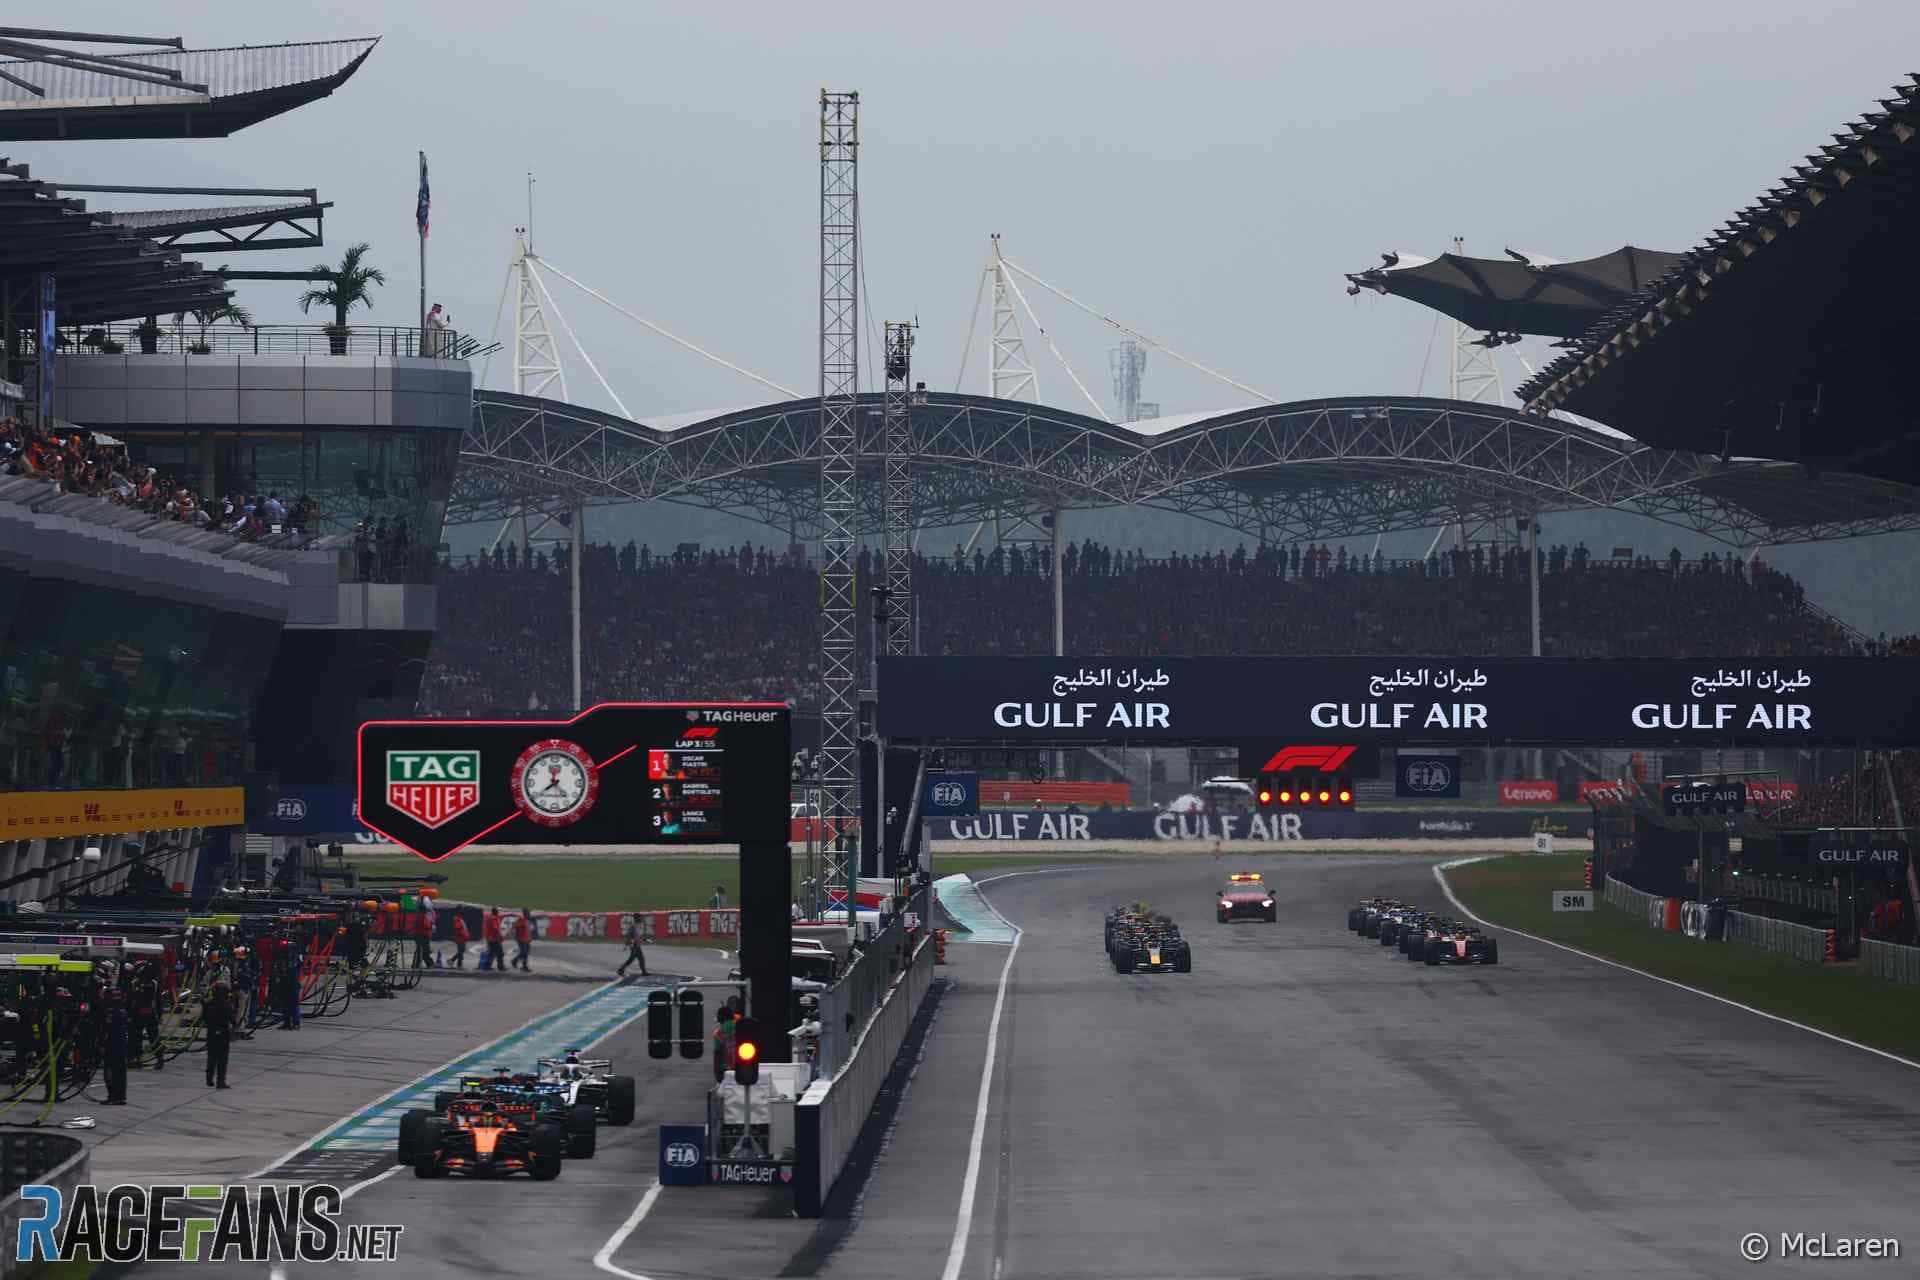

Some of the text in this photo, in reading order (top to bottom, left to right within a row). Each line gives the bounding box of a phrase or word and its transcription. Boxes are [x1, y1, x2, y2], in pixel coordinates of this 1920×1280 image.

[1052, 668, 1170, 697] طيران الخليج
[1369, 668, 1488, 697] طيران الخليج
[1691, 669, 1811, 698] طيران الخليج
[993, 702, 1171, 728] GULF AIR
[1310, 702, 1488, 729] GULF AIR
[1631, 703, 1812, 730] GULF AIR
[675, 740, 694, 748] LAP
[394, 756, 471, 779] TAG
[652, 760, 661, 771] 1
[392, 786, 474, 821] HEUER
[652, 788, 661, 799] 2
[1504, 787, 1552, 800] Lenovo
[1672, 790, 1737, 804] GULF AIR
[652, 815, 661, 826] 3
[950, 813, 1091, 840] GULF AIR
[1154, 812, 1303, 841] GULF AIR
[1818, 849, 1899, 862] GULF AIR
[1562, 896, 1585, 907] SM
